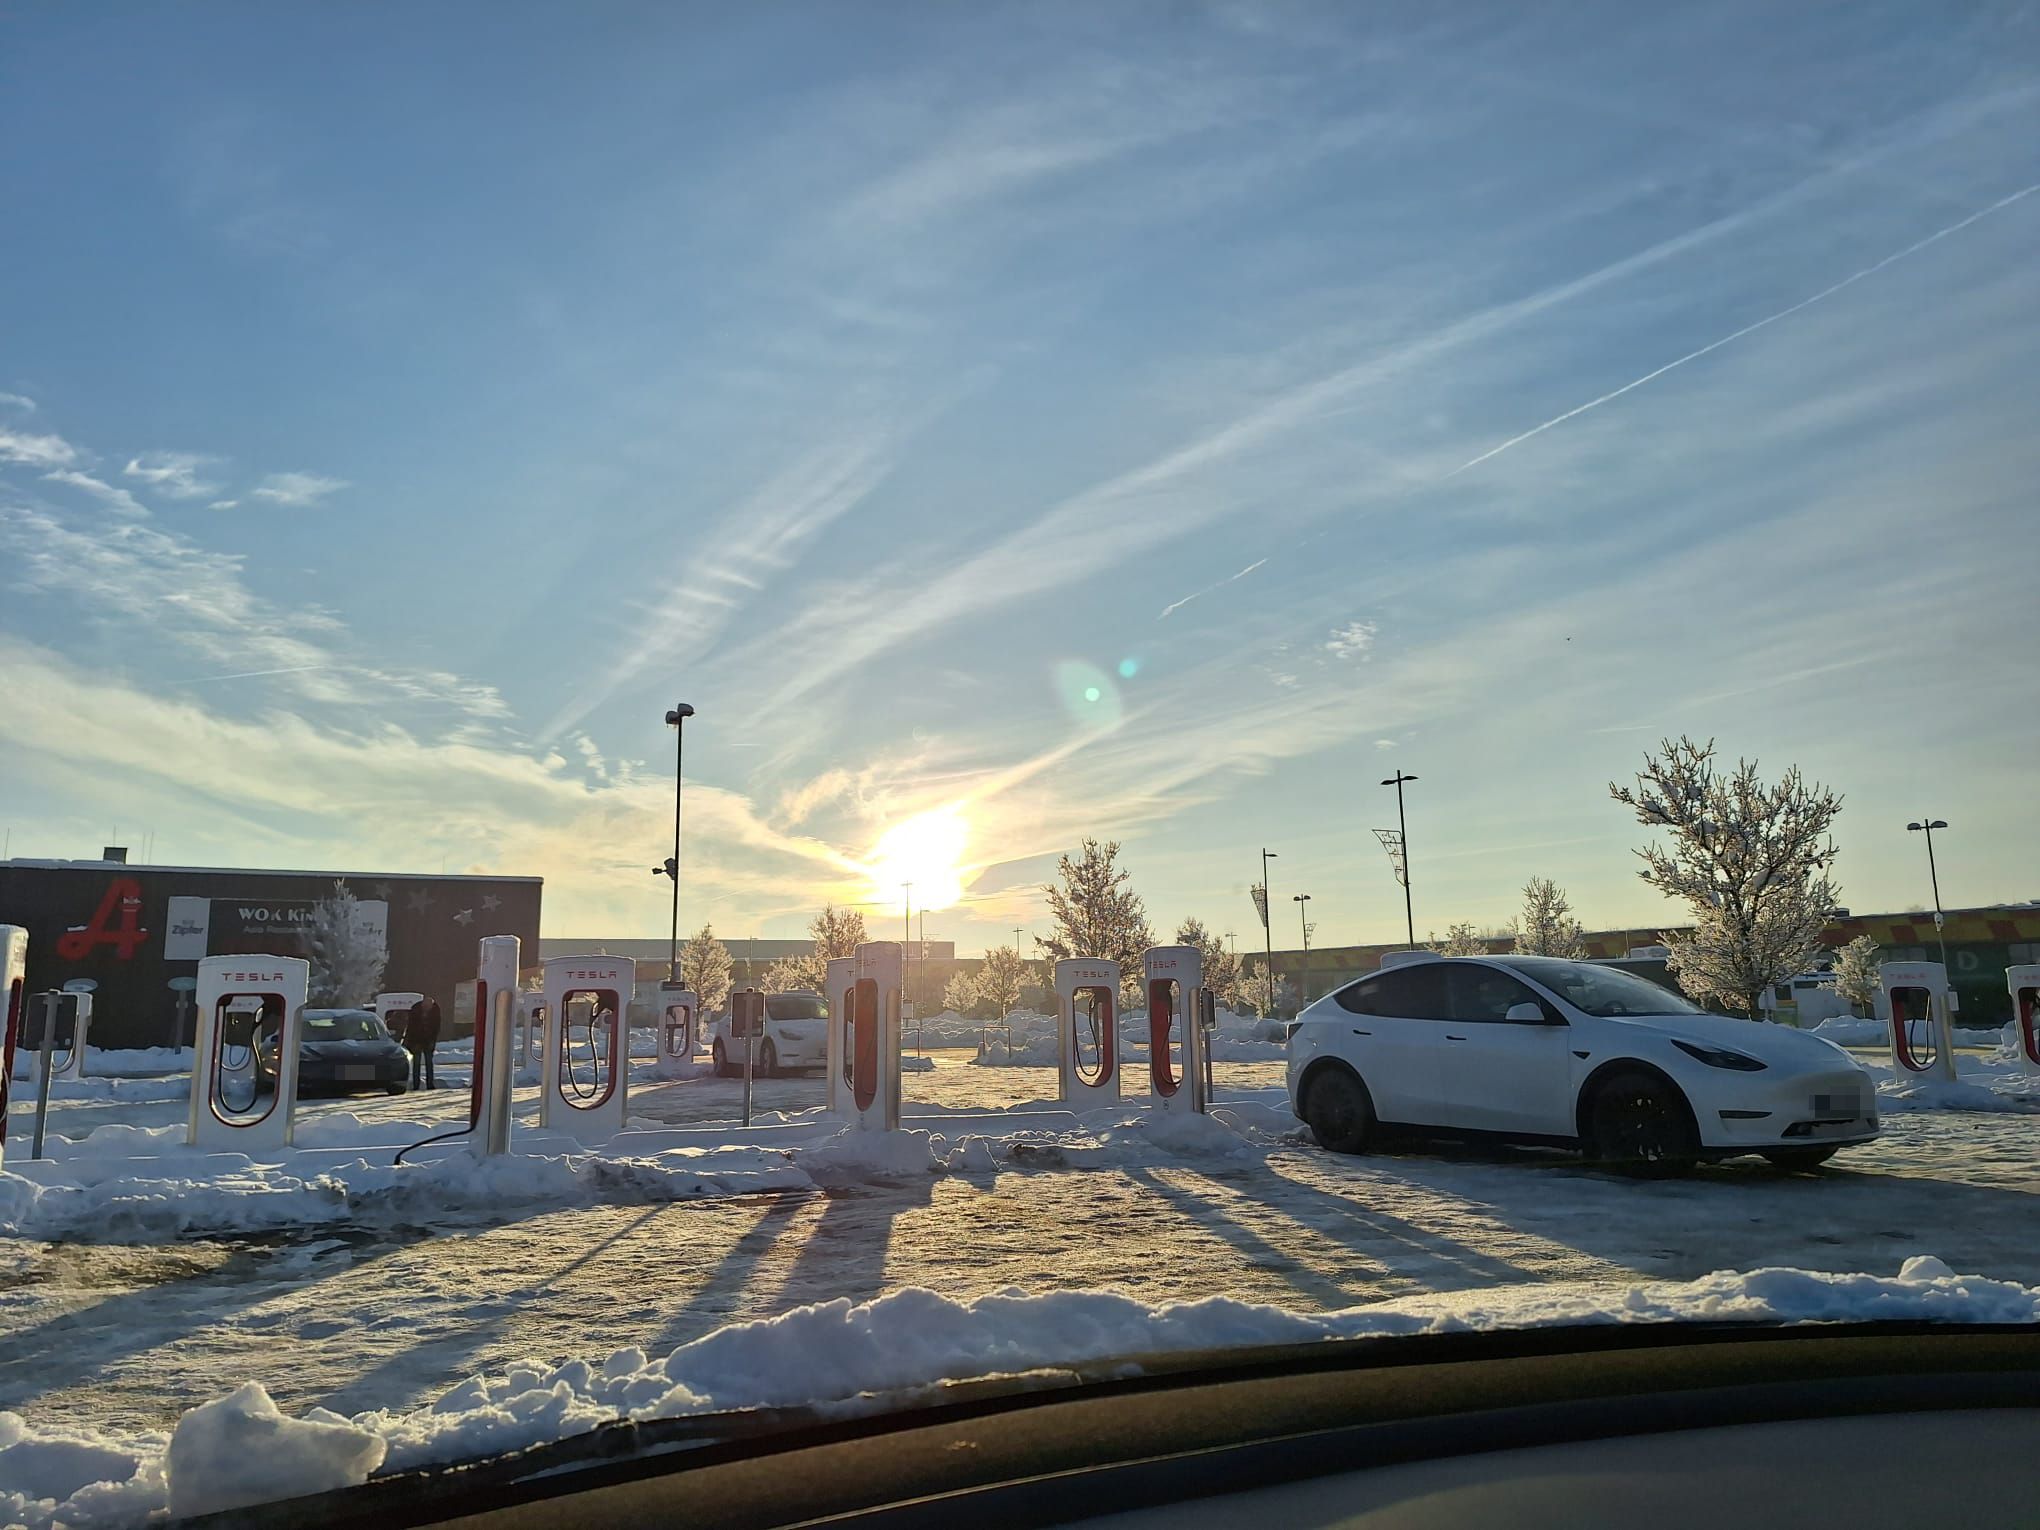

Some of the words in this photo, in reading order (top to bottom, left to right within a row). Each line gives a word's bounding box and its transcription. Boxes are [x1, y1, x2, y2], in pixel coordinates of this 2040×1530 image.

[238, 907, 282, 921] WOK
[1147, 959, 1178, 969] TESLA
[221, 972, 284, 982] TESLA
[565, 970, 617, 979] TESLA
[1072, 970, 1110, 978] TESLA
